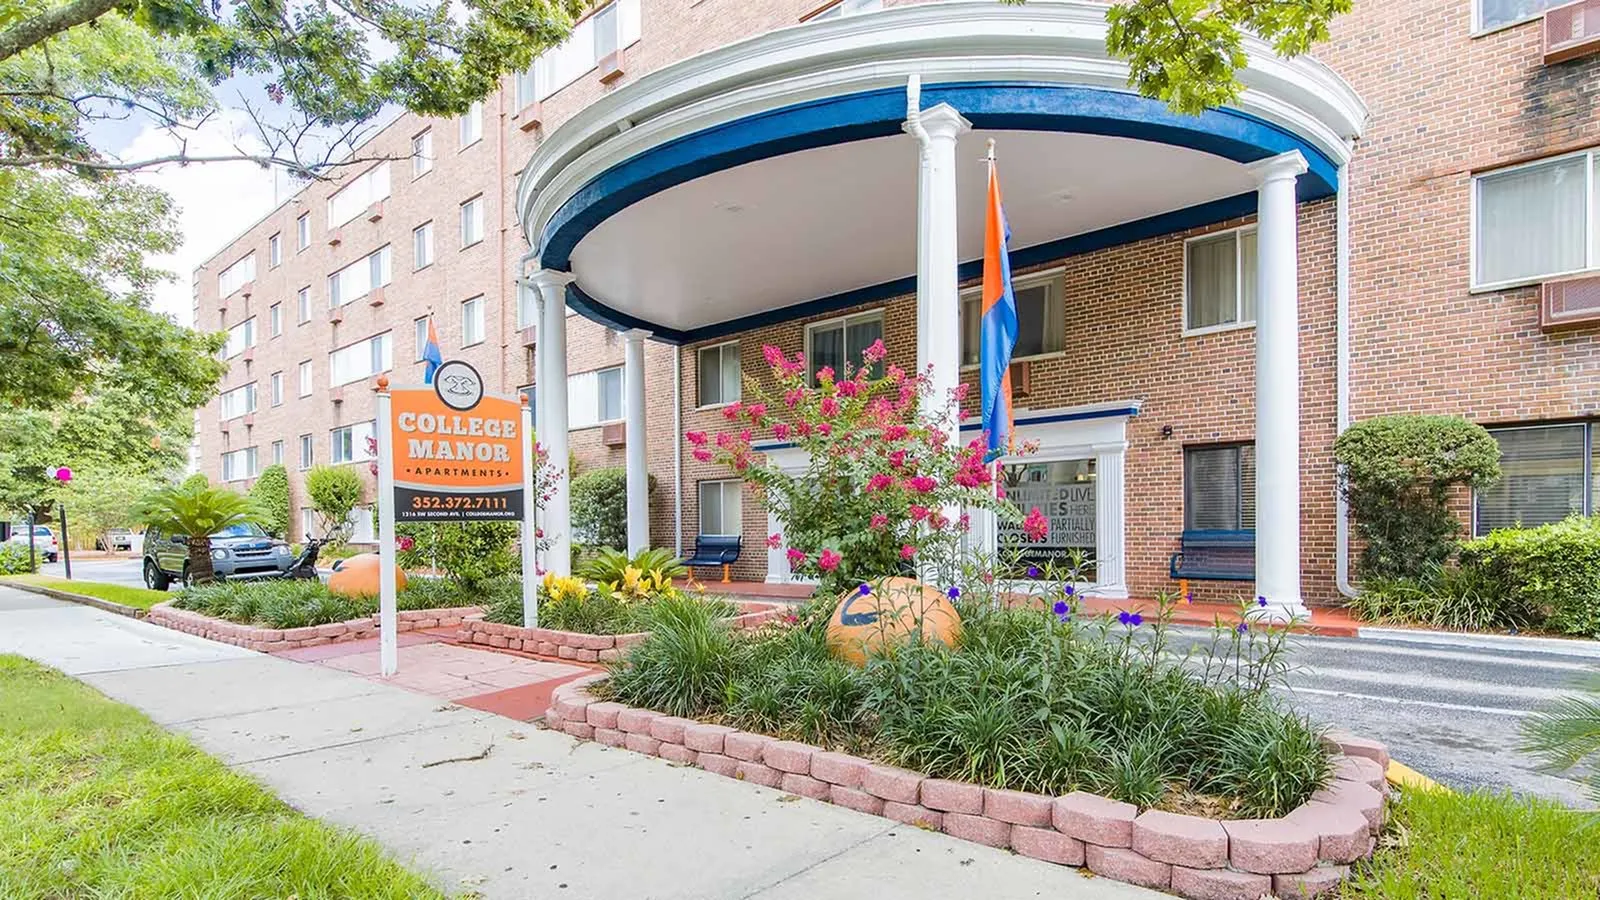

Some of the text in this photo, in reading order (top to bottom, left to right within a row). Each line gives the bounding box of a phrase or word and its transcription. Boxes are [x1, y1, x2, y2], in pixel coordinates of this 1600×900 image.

[398, 412, 517, 438] COLLEGE
[407, 439, 511, 462] MANOR
[415, 468, 502, 477] APARTMENTS
[412, 496, 508, 509] 352.372.7111
[1051, 517, 1095, 532] PARTIALLY
[997, 532, 1048, 544] COSES
[1051, 531, 1096, 544] FURNISHED
